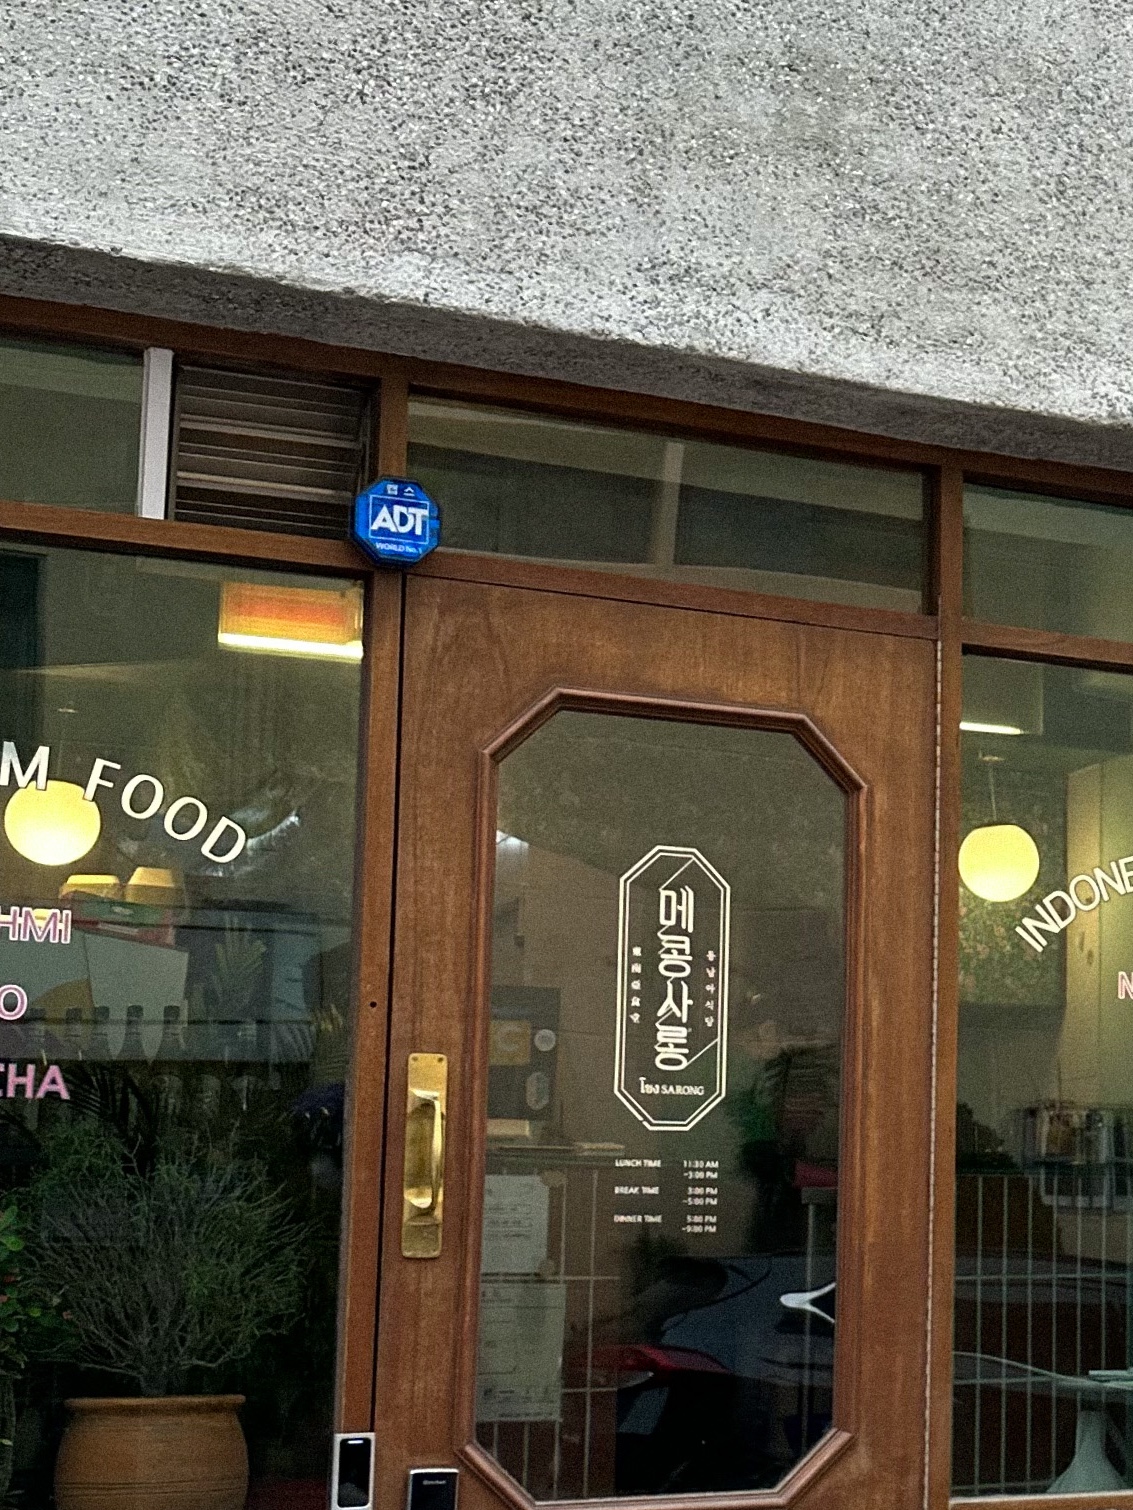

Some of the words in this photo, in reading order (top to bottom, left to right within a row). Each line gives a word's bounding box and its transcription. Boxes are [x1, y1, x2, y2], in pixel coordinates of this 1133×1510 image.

[370, 504, 428, 536] ADT
[375, 542, 405, 552] WORLD
[0, 741, 50, 791] M
[83, 757, 247, 863] FOOD
[652, 884, 694, 1071] 메콩사롱
[661, 1084, 705, 1096] SARONG
[615, 1159, 642, 1167] LUNCH
[643, 1159, 661, 1167] TIME
[706, 1171, 718, 1179] PM
[614, 1186, 639, 1195] BREAK
[642, 1186, 659, 1195] TIME
[705, 1187, 718, 1195] PM
[705, 1197, 718, 1205] PM
[614, 1215, 642, 1223] DINNER
[644, 1215, 662, 1223] TIME
[704, 1215, 717, 1223] PM
[704, 1225, 717, 1233] PM
